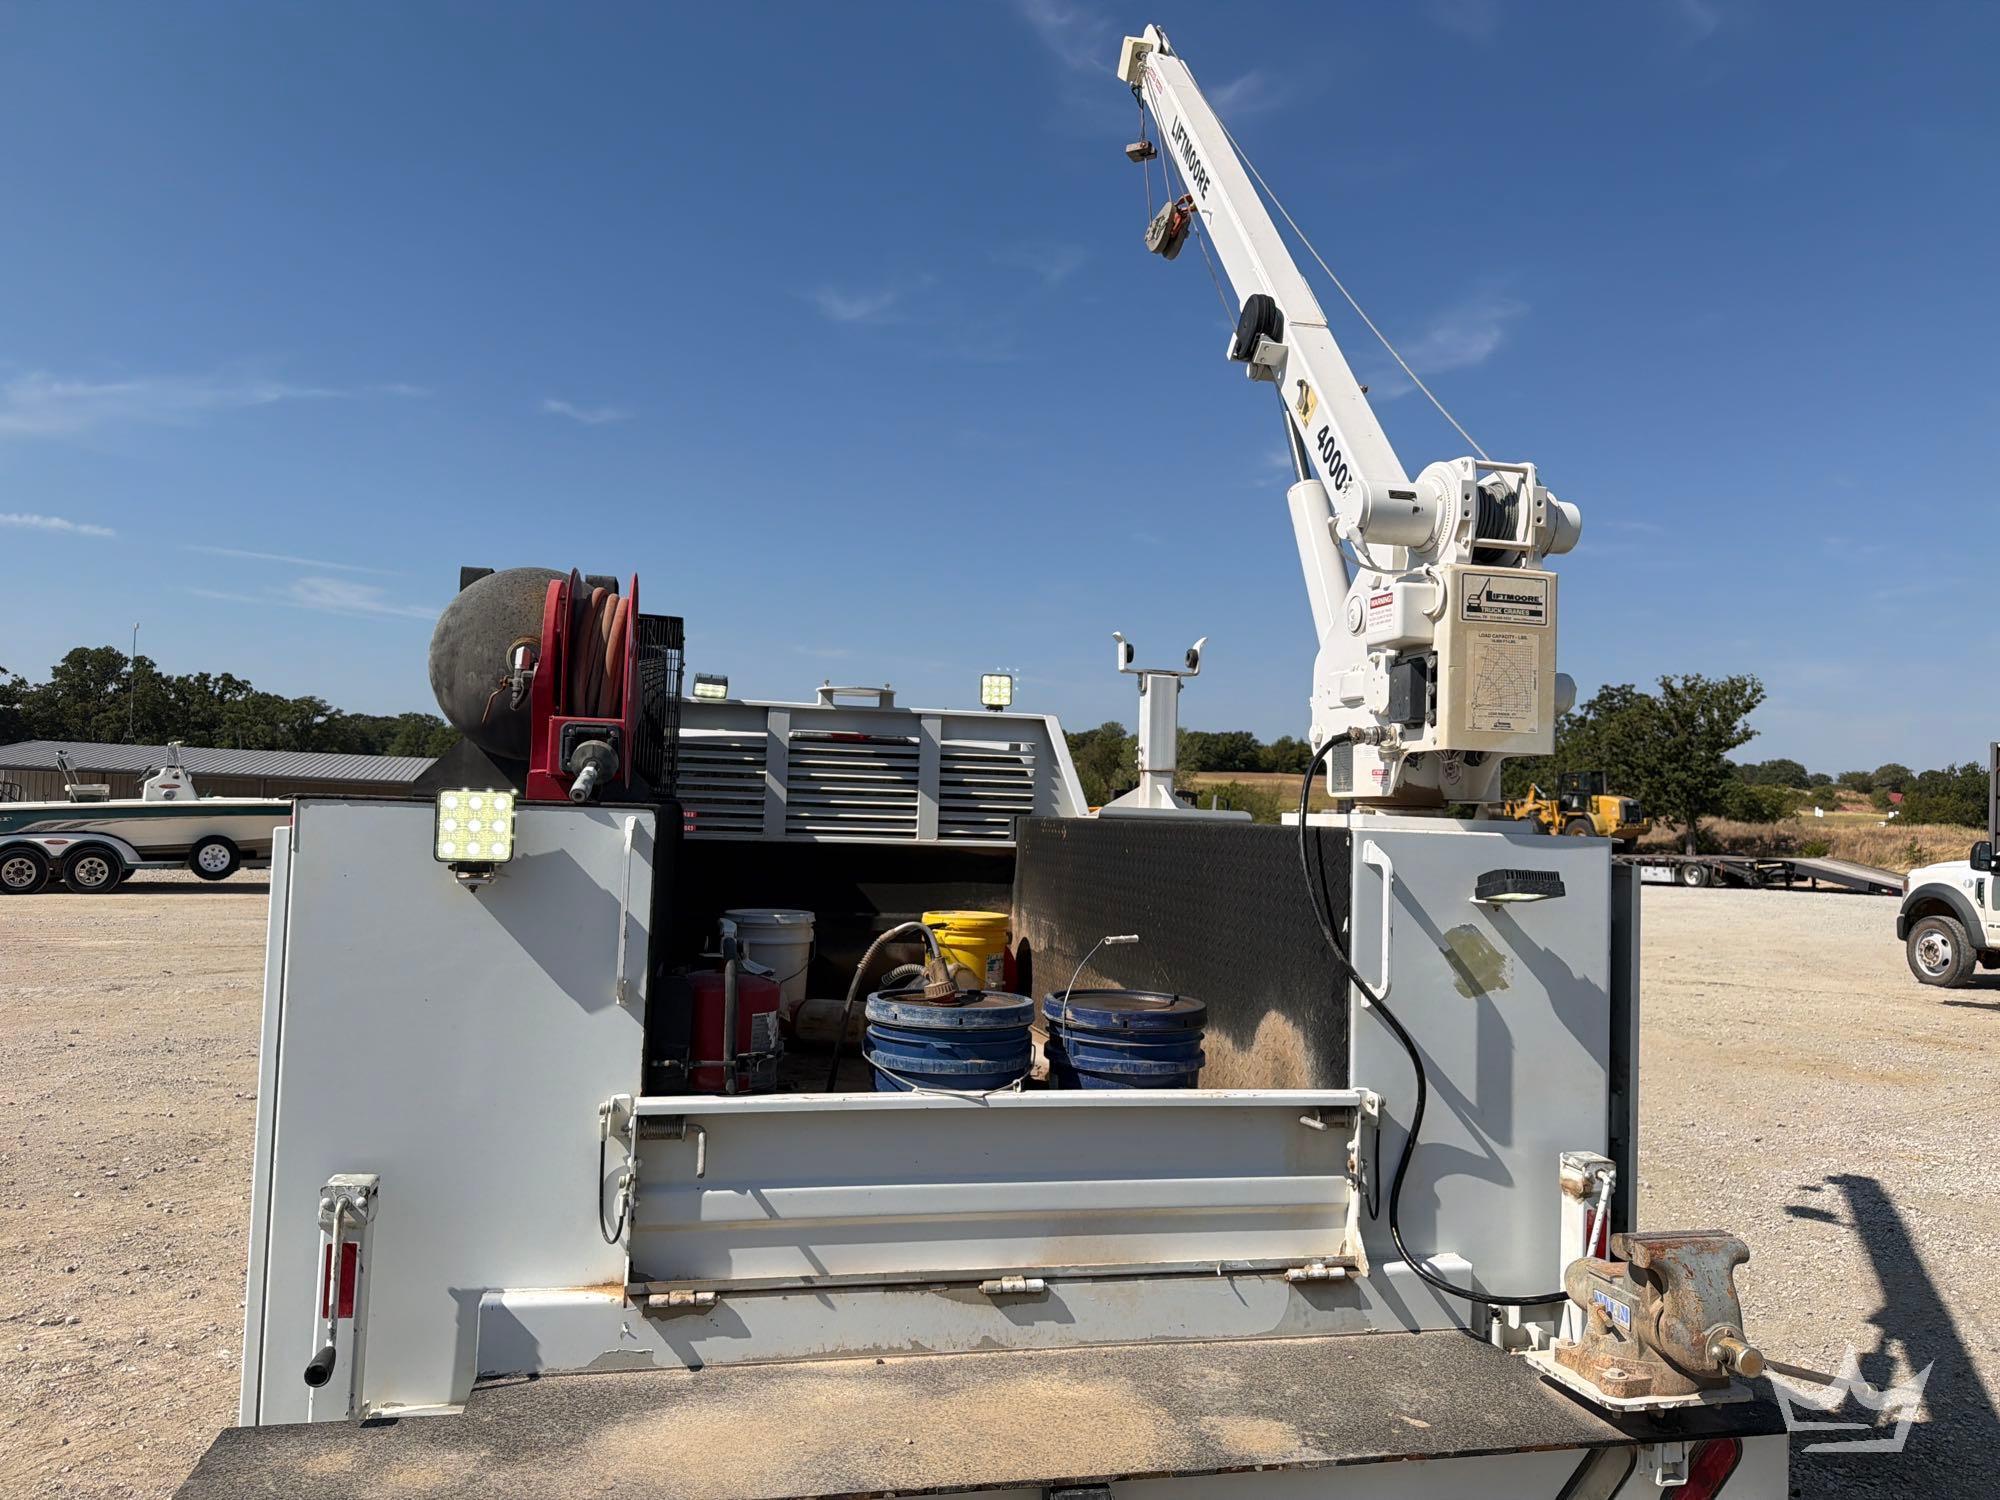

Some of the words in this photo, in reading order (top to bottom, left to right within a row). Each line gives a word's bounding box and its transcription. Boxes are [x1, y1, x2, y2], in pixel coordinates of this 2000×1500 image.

[1171, 115, 1211, 201] LIFTMOORE
[1486, 590, 1541, 605] LIFTMOORE
[1481, 606, 1502, 614] TRUCK
[1503, 607, 1530, 616] CRANES
